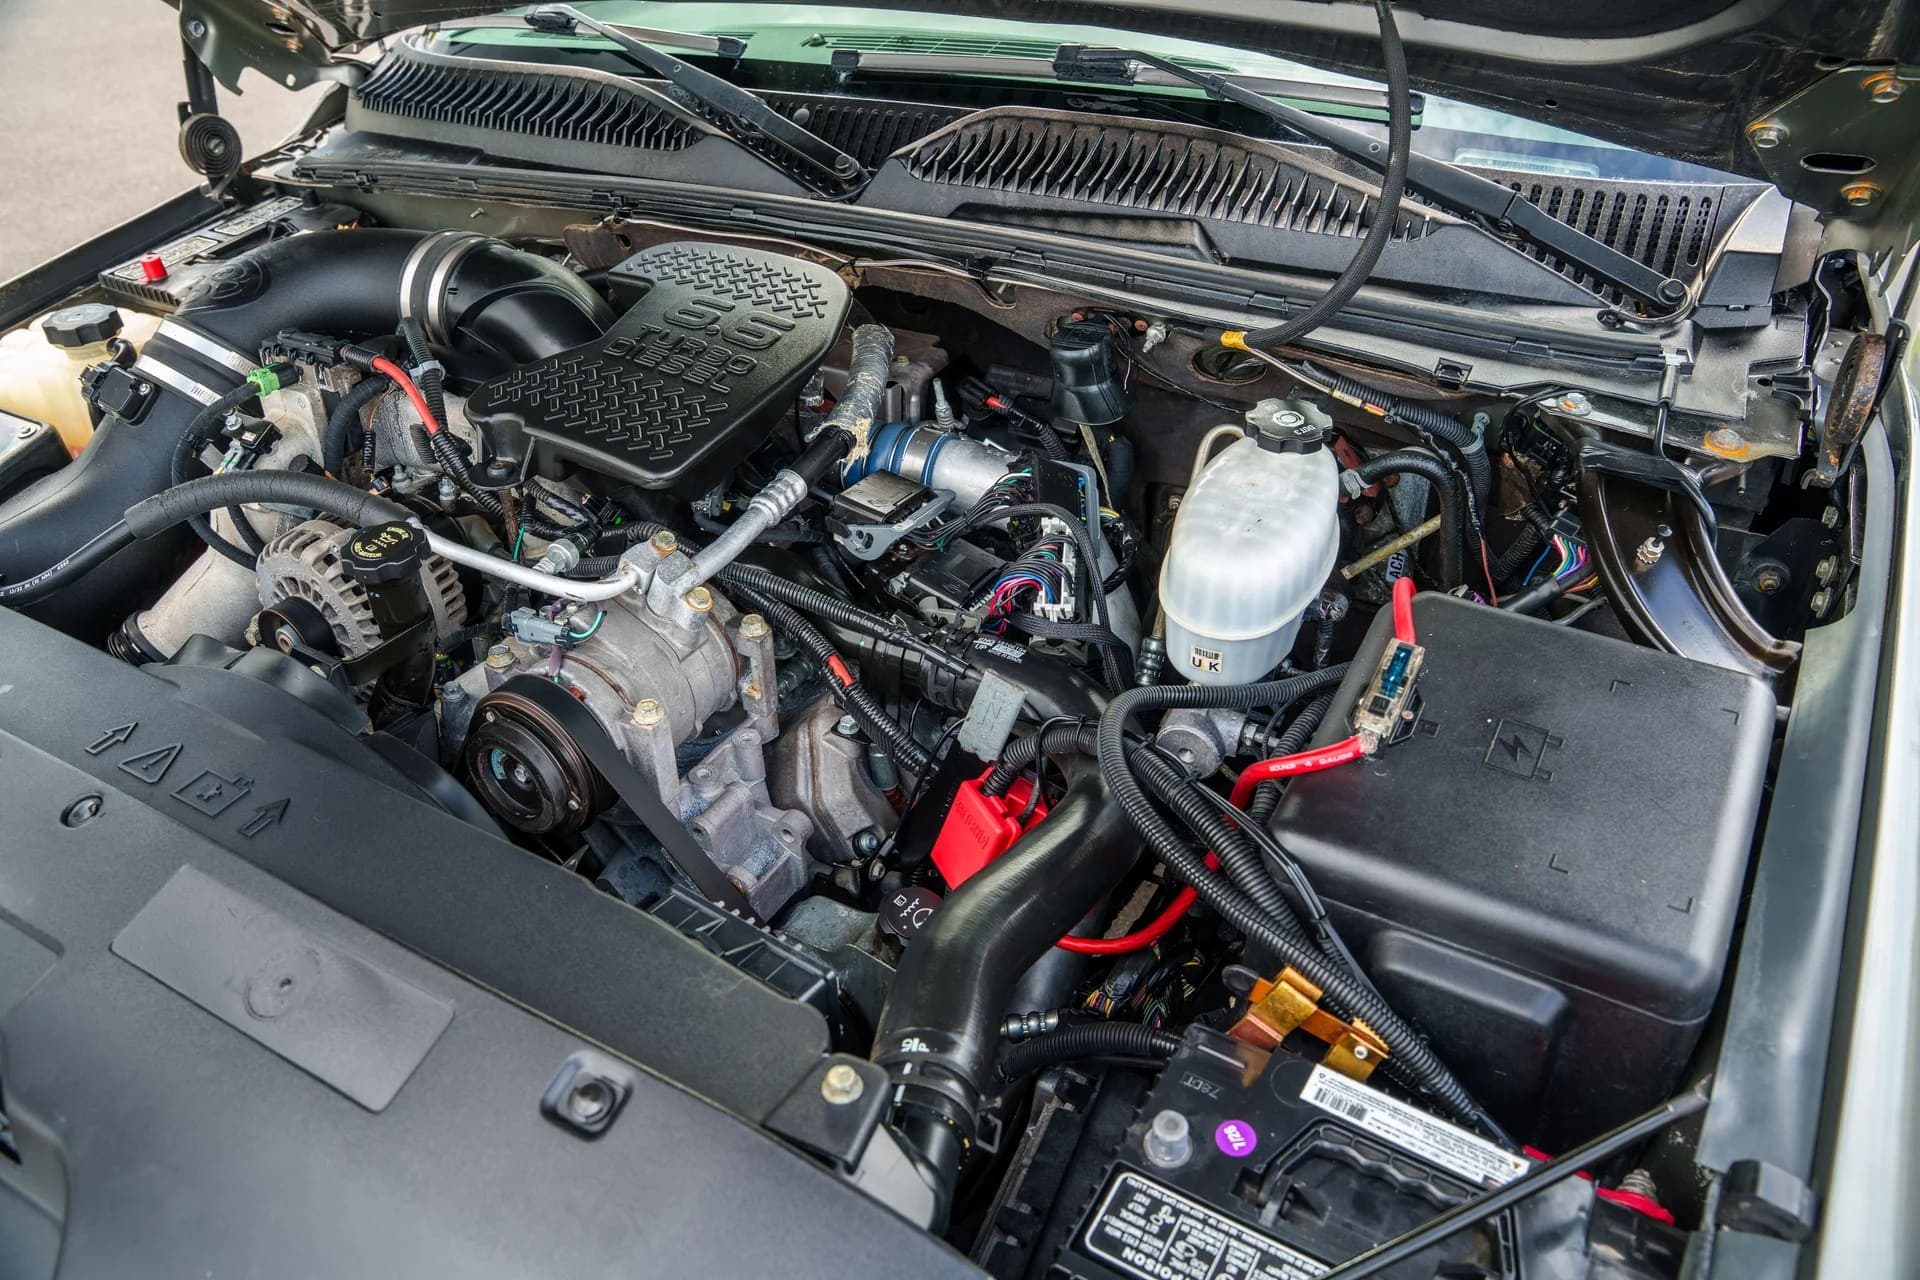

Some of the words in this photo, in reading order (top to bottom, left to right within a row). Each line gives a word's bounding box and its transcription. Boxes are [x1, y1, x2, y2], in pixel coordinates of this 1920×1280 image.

[635, 322, 758, 374] TURBO
[663, 294, 796, 350] 6.6
[603, 337, 731, 394] DIESEL
[1121, 1246, 1185, 1280] POISON
